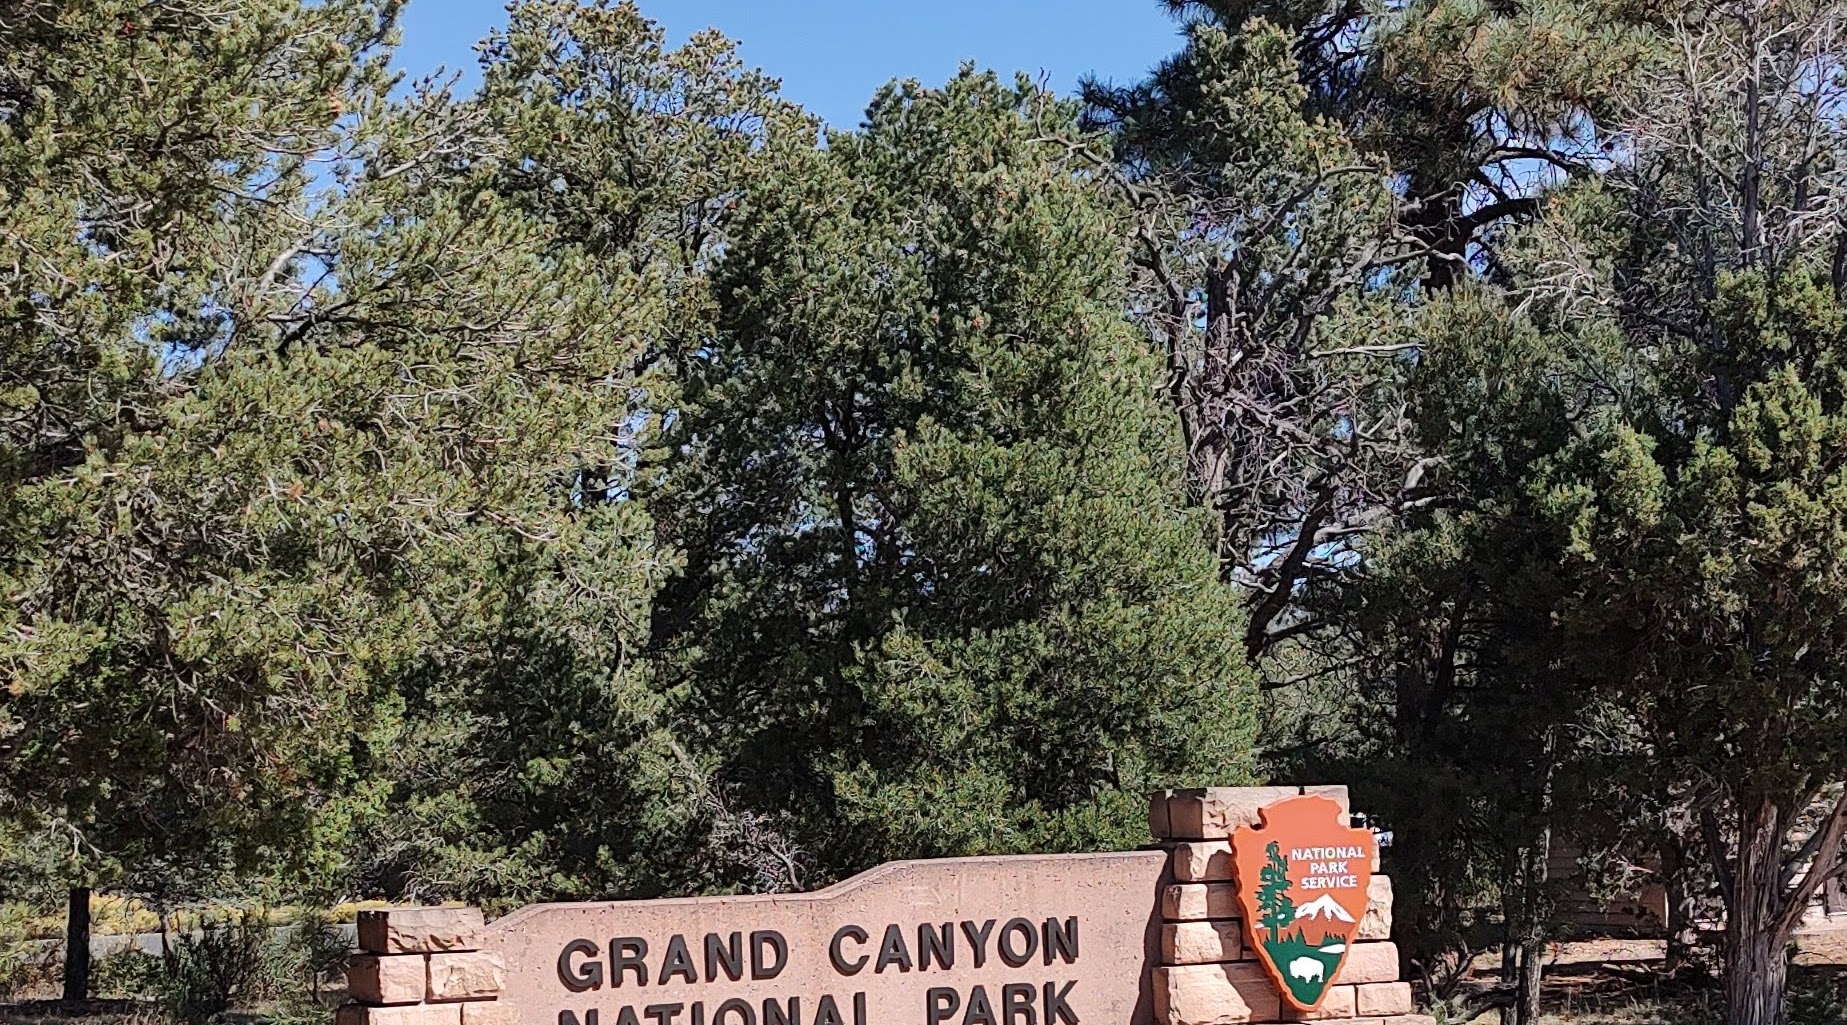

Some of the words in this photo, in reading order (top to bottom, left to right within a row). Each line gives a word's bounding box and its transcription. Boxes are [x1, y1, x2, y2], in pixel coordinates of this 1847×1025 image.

[1291, 847, 1366, 861] NATIONAL
[1310, 861, 1348, 875] PARK
[1300, 875, 1358, 889] SERVICE
[557, 930, 789, 992] GRAND
[828, 916, 1080, 976] CANYON
